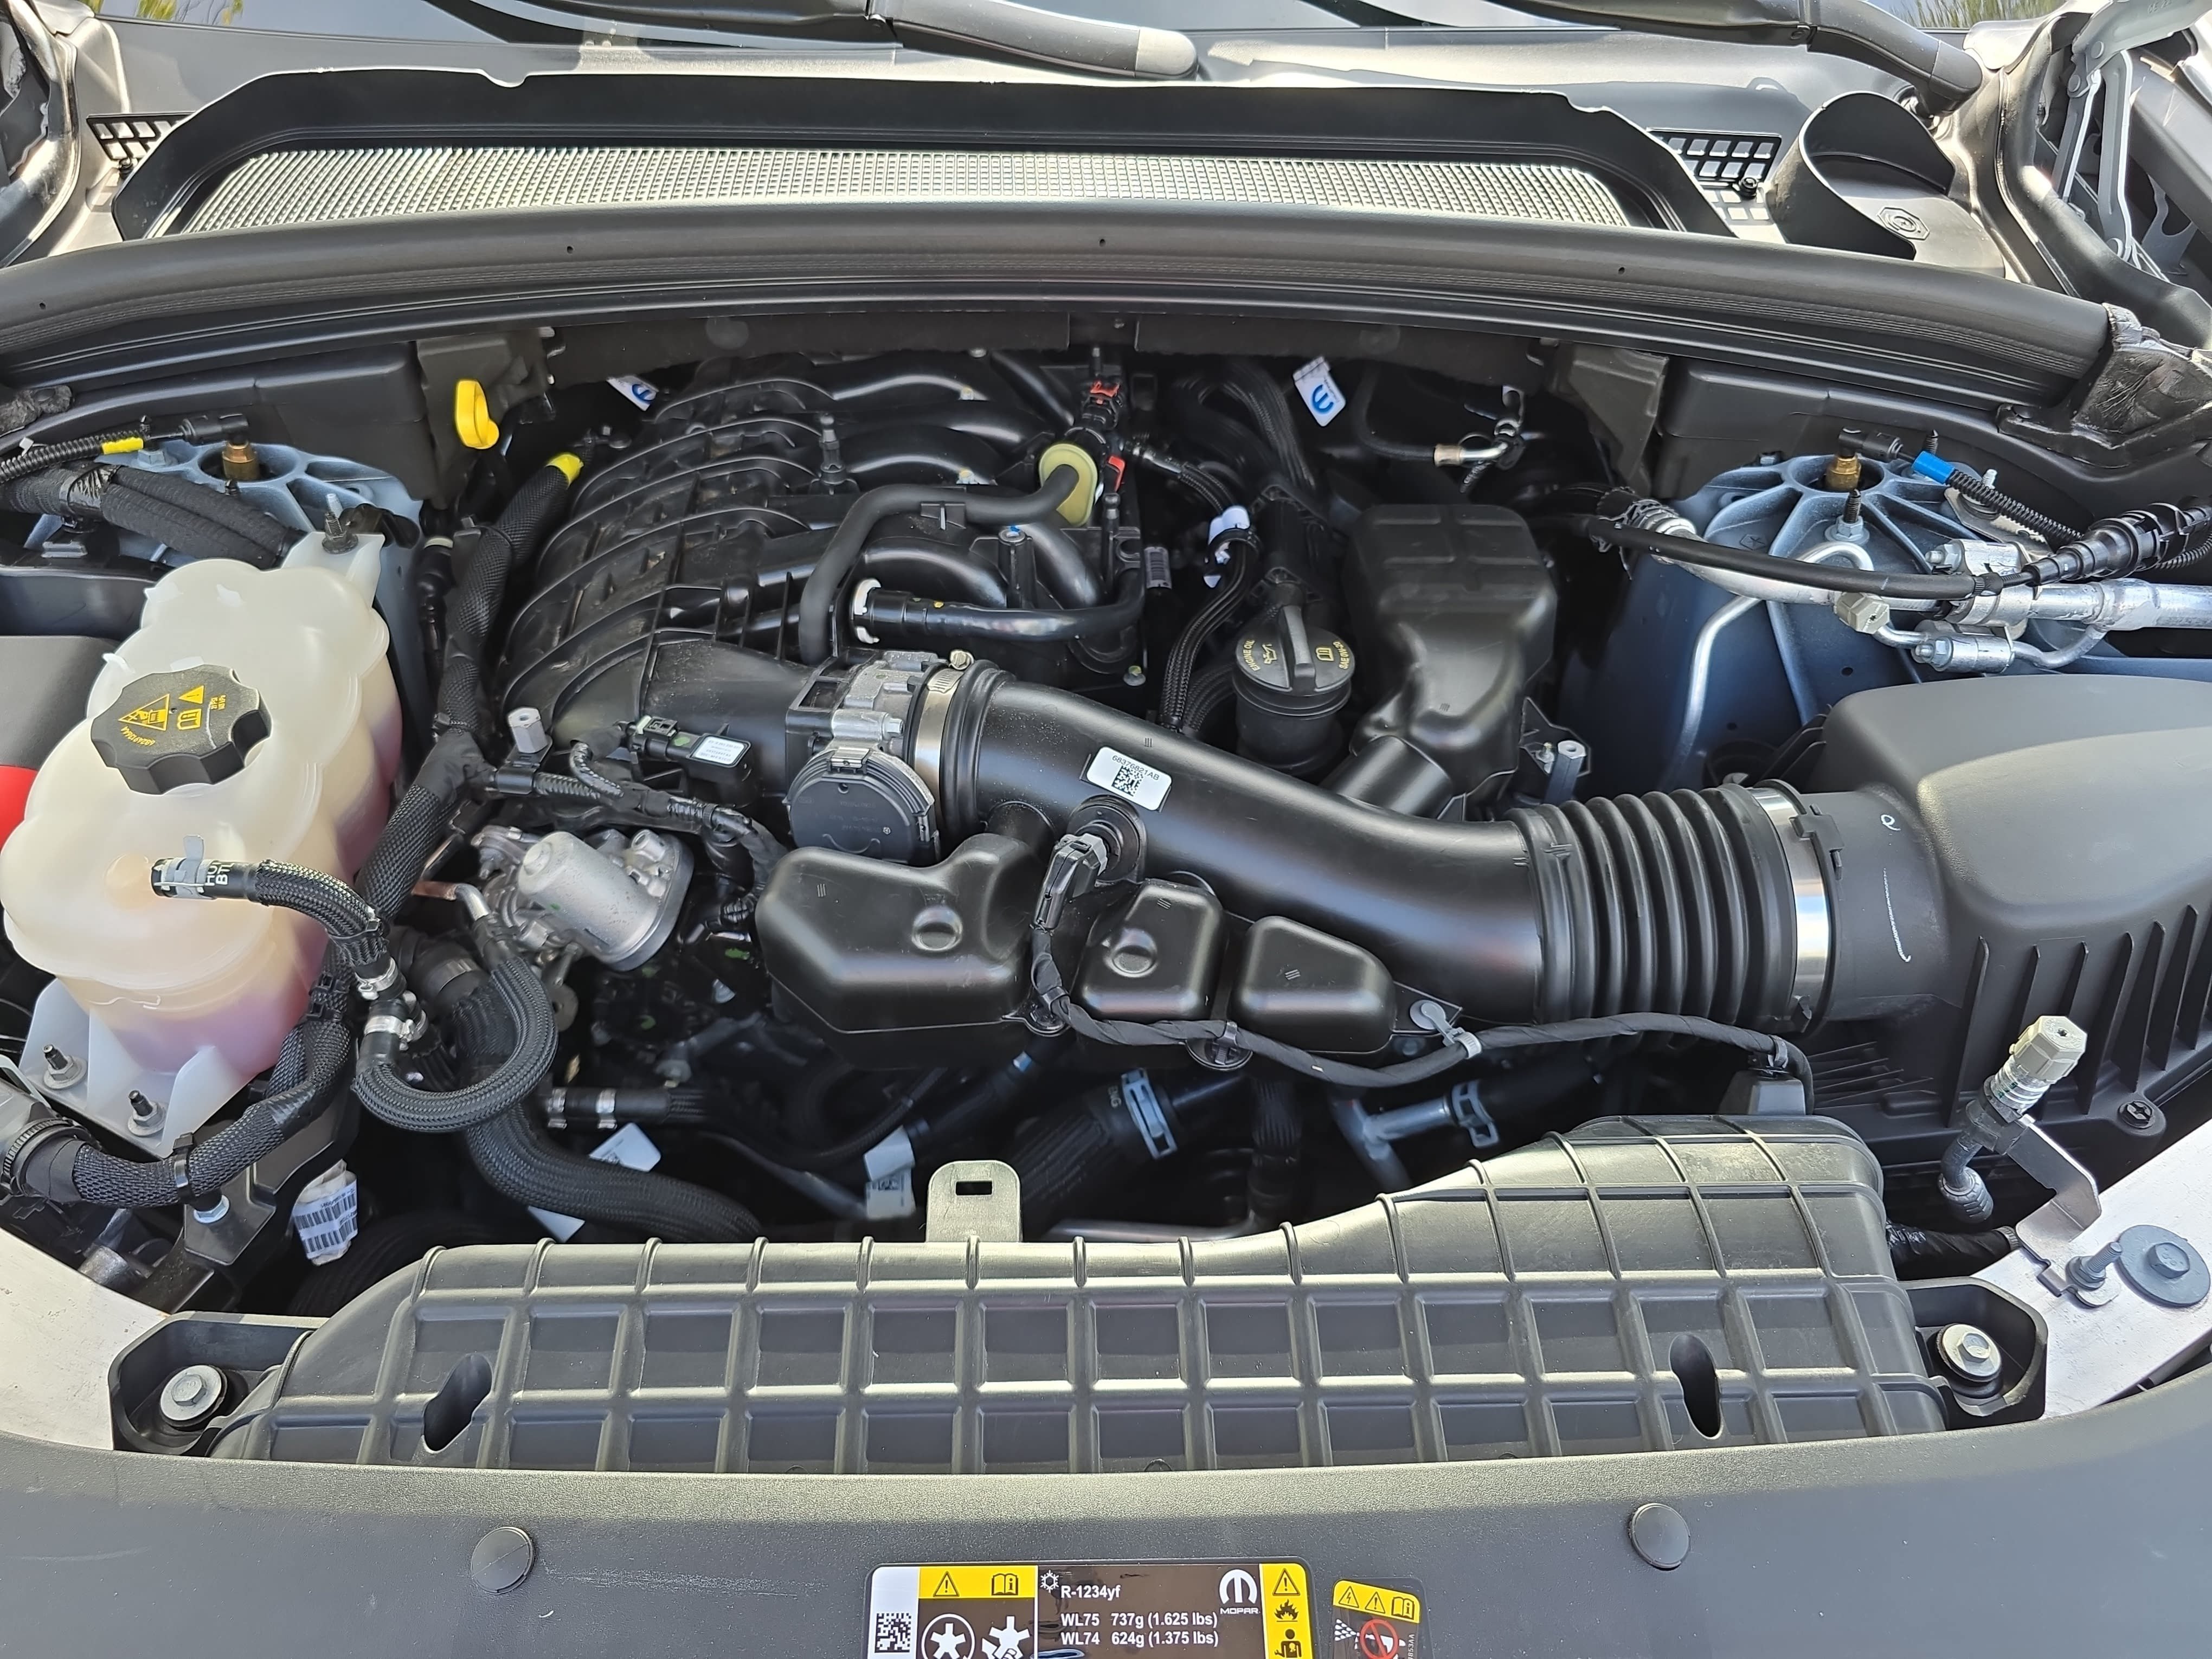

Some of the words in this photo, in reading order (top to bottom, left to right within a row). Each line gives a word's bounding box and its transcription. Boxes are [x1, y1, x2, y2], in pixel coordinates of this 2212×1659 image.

[1243, 640, 1255, 649] OIL
[1333, 641, 1349, 658] 0W-20
[1243, 650, 1261, 671] ENGINE
[1338, 657, 1349, 670] SAE
[1112, 755, 1160, 781] 68376821AB
[1060, 1585, 1121, 1601] R-1234yf
[1060, 1613, 1100, 1626] WL75
[1111, 1613, 1144, 1629] 737g
[1148, 1612, 1189, 1629] (1.625
[1192, 1612, 1218, 1629] lbs)
[1061, 1631, 1101, 1645] WL74
[1111, 1631, 1144, 1648] 624g
[1148, 1631, 1189, 1648] (1.375
[1193, 1630, 1219, 1647] lbs)
